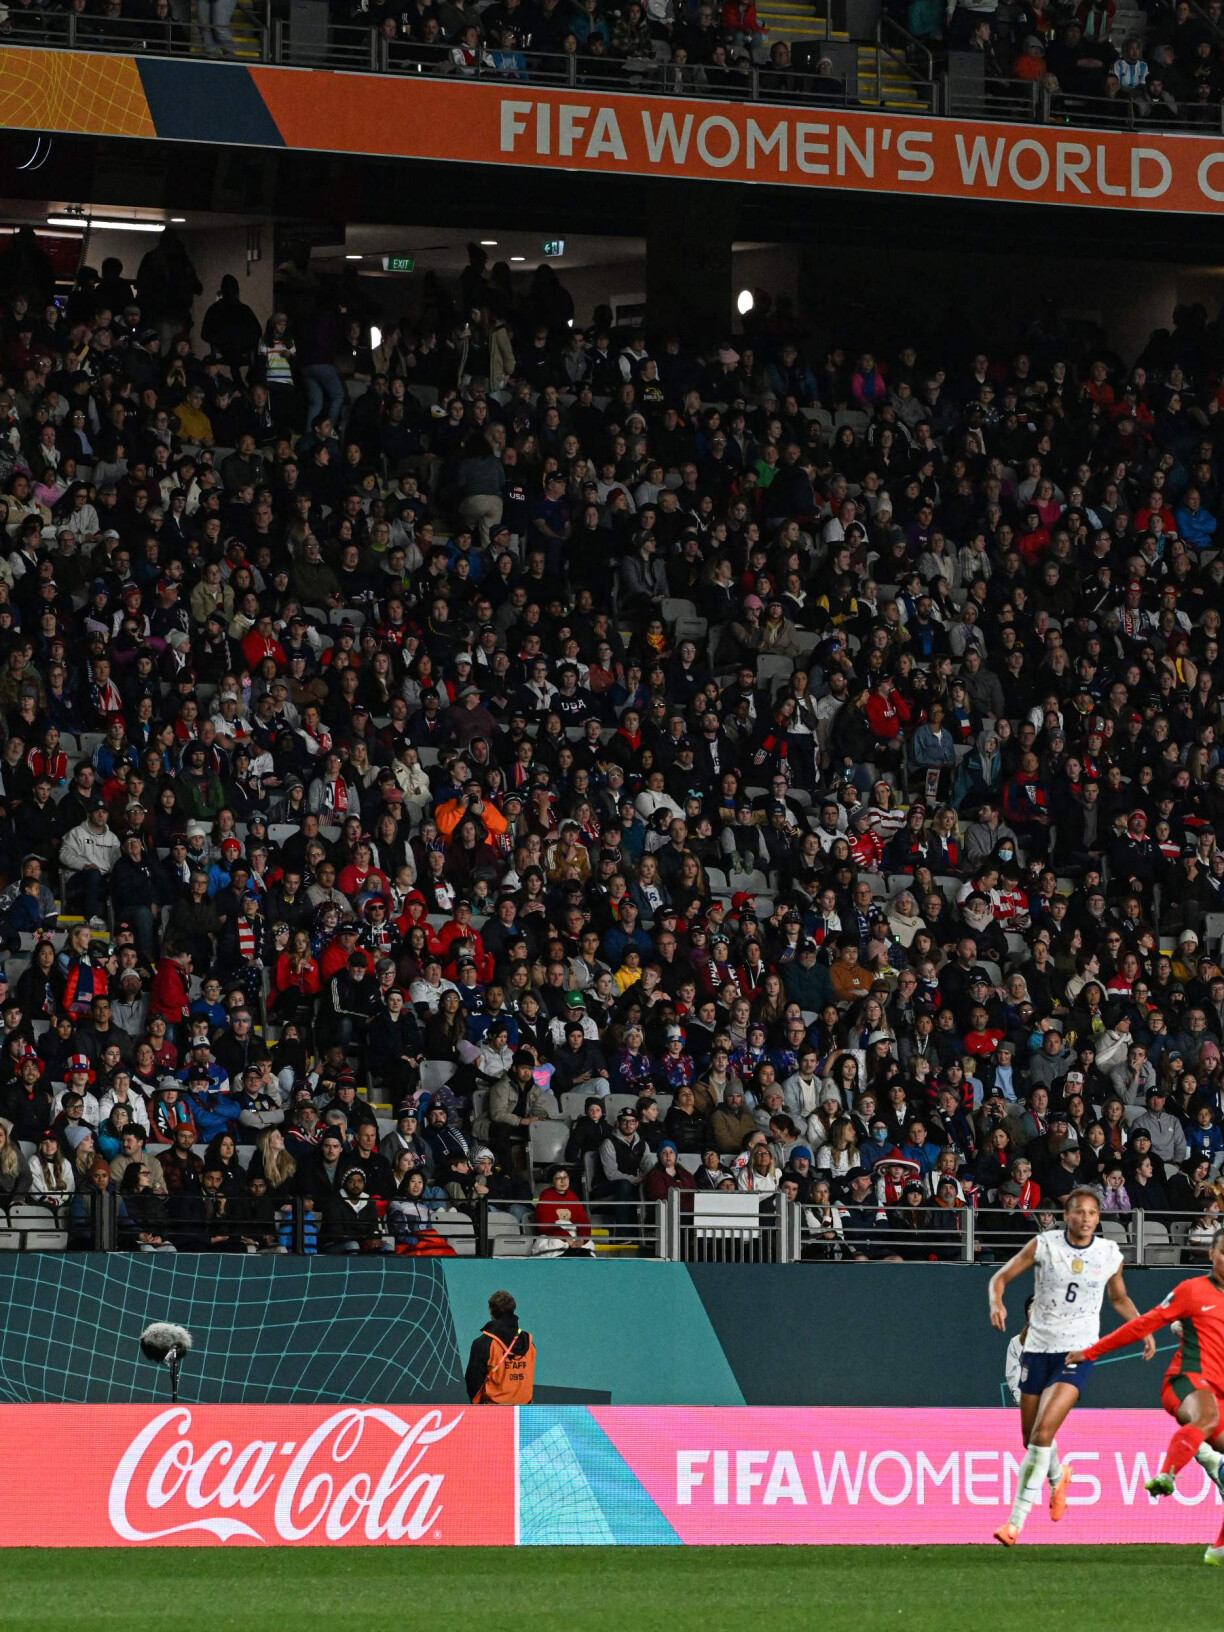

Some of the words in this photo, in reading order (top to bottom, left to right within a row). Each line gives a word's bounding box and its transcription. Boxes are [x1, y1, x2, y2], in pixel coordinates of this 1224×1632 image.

[501, 101, 628, 160] FIFA
[641, 111, 935, 182] WOMEN'S
[955, 135, 1173, 197] WORLD
[393, 259, 409, 269] EXIT
[561, 699, 587, 711] USA
[1065, 1282, 1079, 1303] 6
[505, 1361, 527, 1369] STAFF
[109, 1406, 465, 1542] Coca-Cola
[677, 1450, 807, 1505] FIFA
